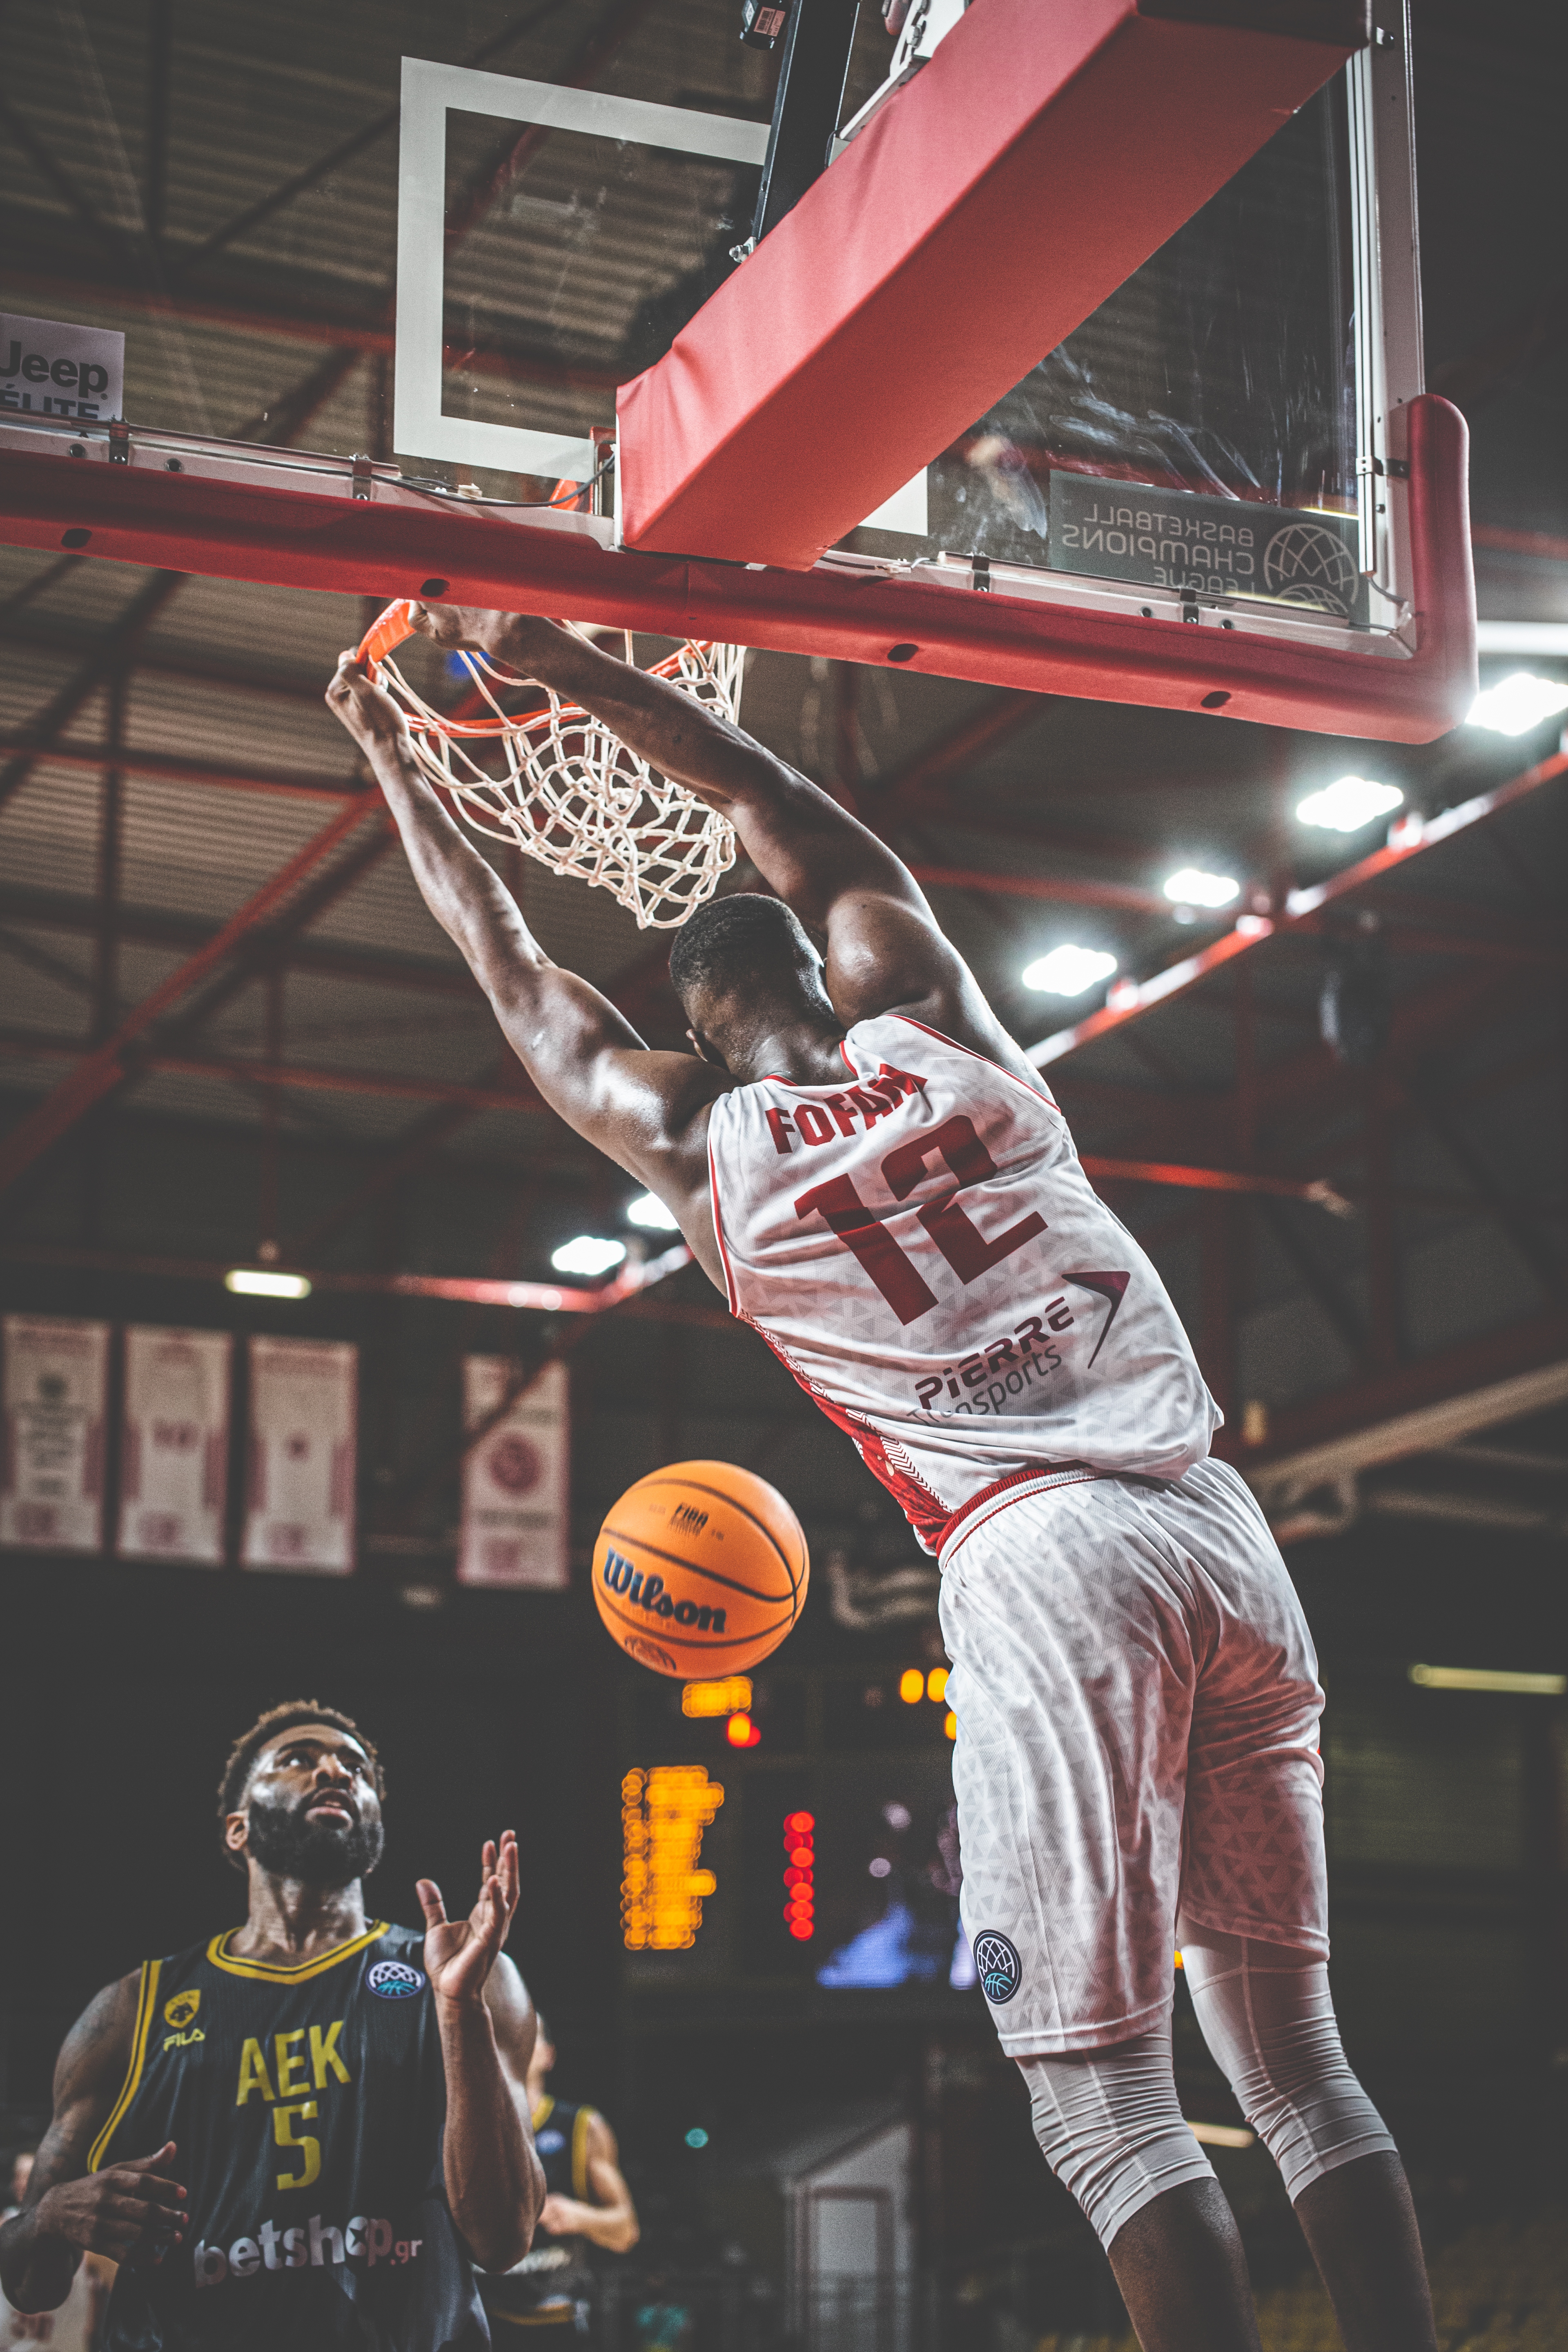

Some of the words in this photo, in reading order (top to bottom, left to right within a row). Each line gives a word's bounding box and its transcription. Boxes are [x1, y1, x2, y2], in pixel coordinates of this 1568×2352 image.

[765, 1063, 928, 1155] FOFAN
[794, 1115, 1049, 1326] 12
[603, 1545, 727, 1633] Wilson
[163, 2027, 206, 2052] FILA
[236, 2020, 352, 2106] AEK
[272, 2100, 322, 2190] 5
